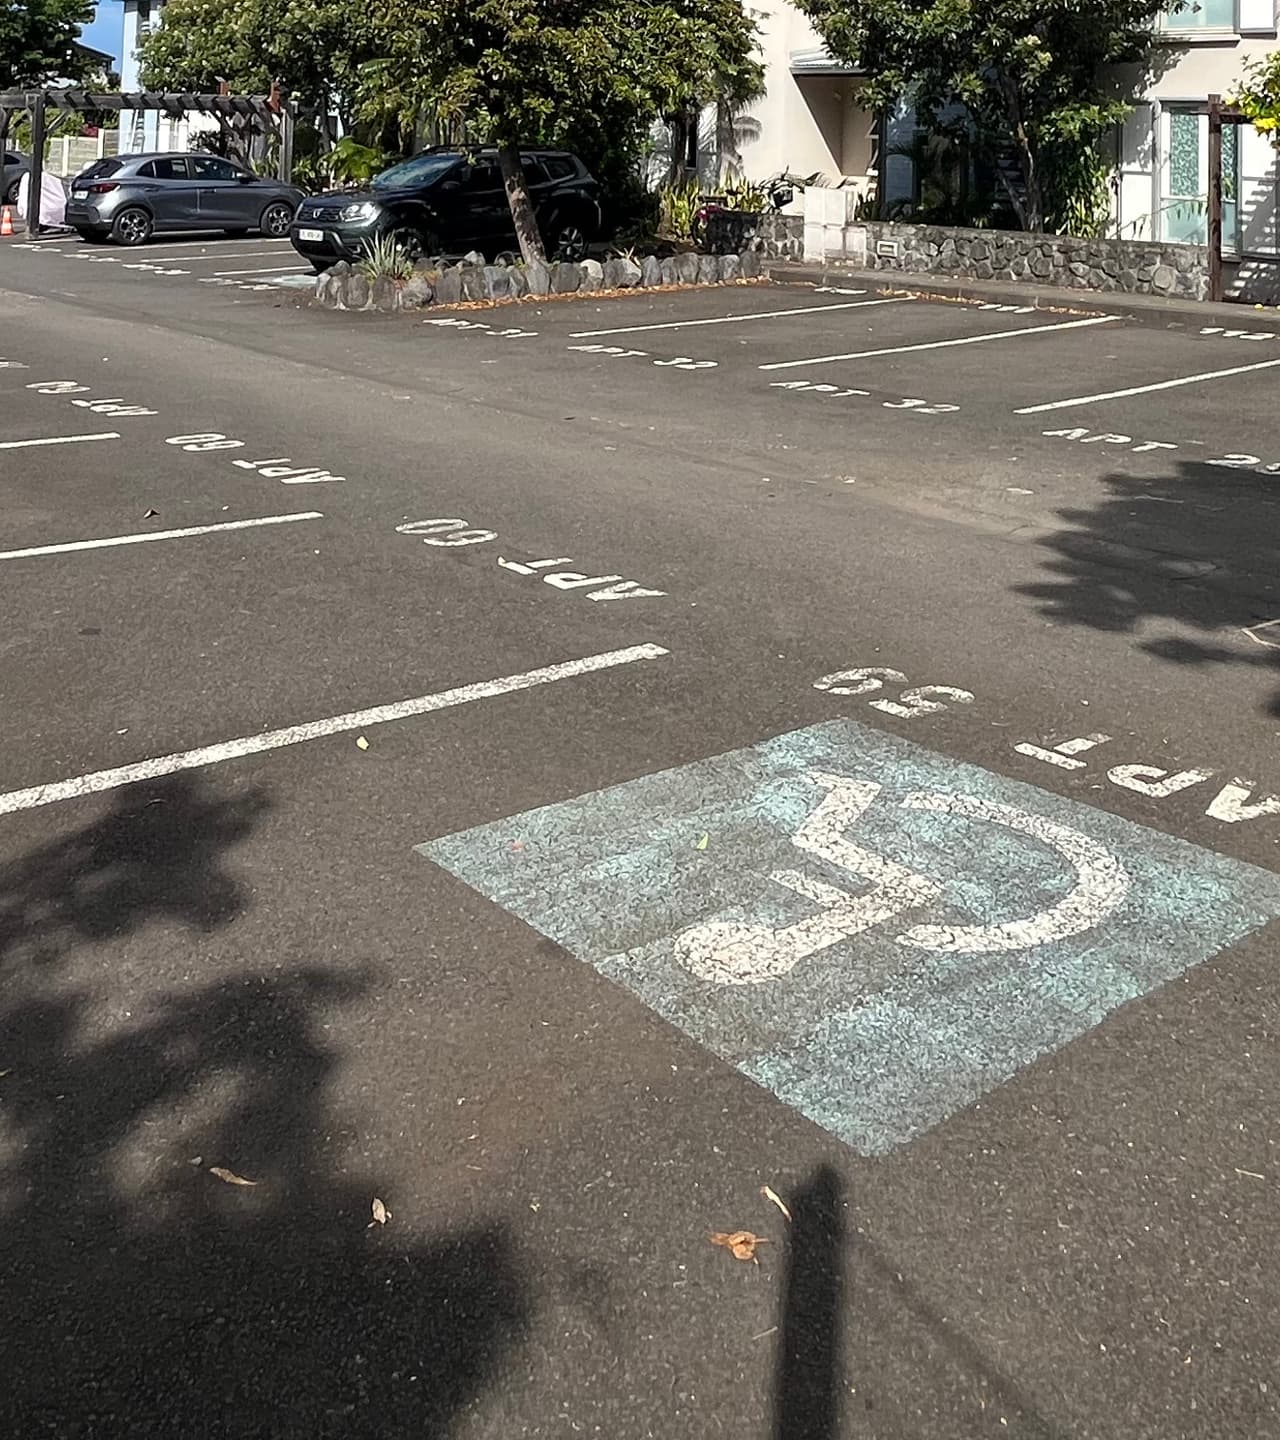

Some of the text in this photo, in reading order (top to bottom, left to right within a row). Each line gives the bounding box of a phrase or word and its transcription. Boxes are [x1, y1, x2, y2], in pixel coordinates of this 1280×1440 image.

[568, 344, 649, 358] APT
[71, 398, 158, 417] APT
[769, 381, 961, 415] APT 32
[1042, 427, 1179, 452] APT
[164, 433, 347, 484] APT 60
[394, 517, 669, 602] APT 60
[813, 666, 976, 720] 59
